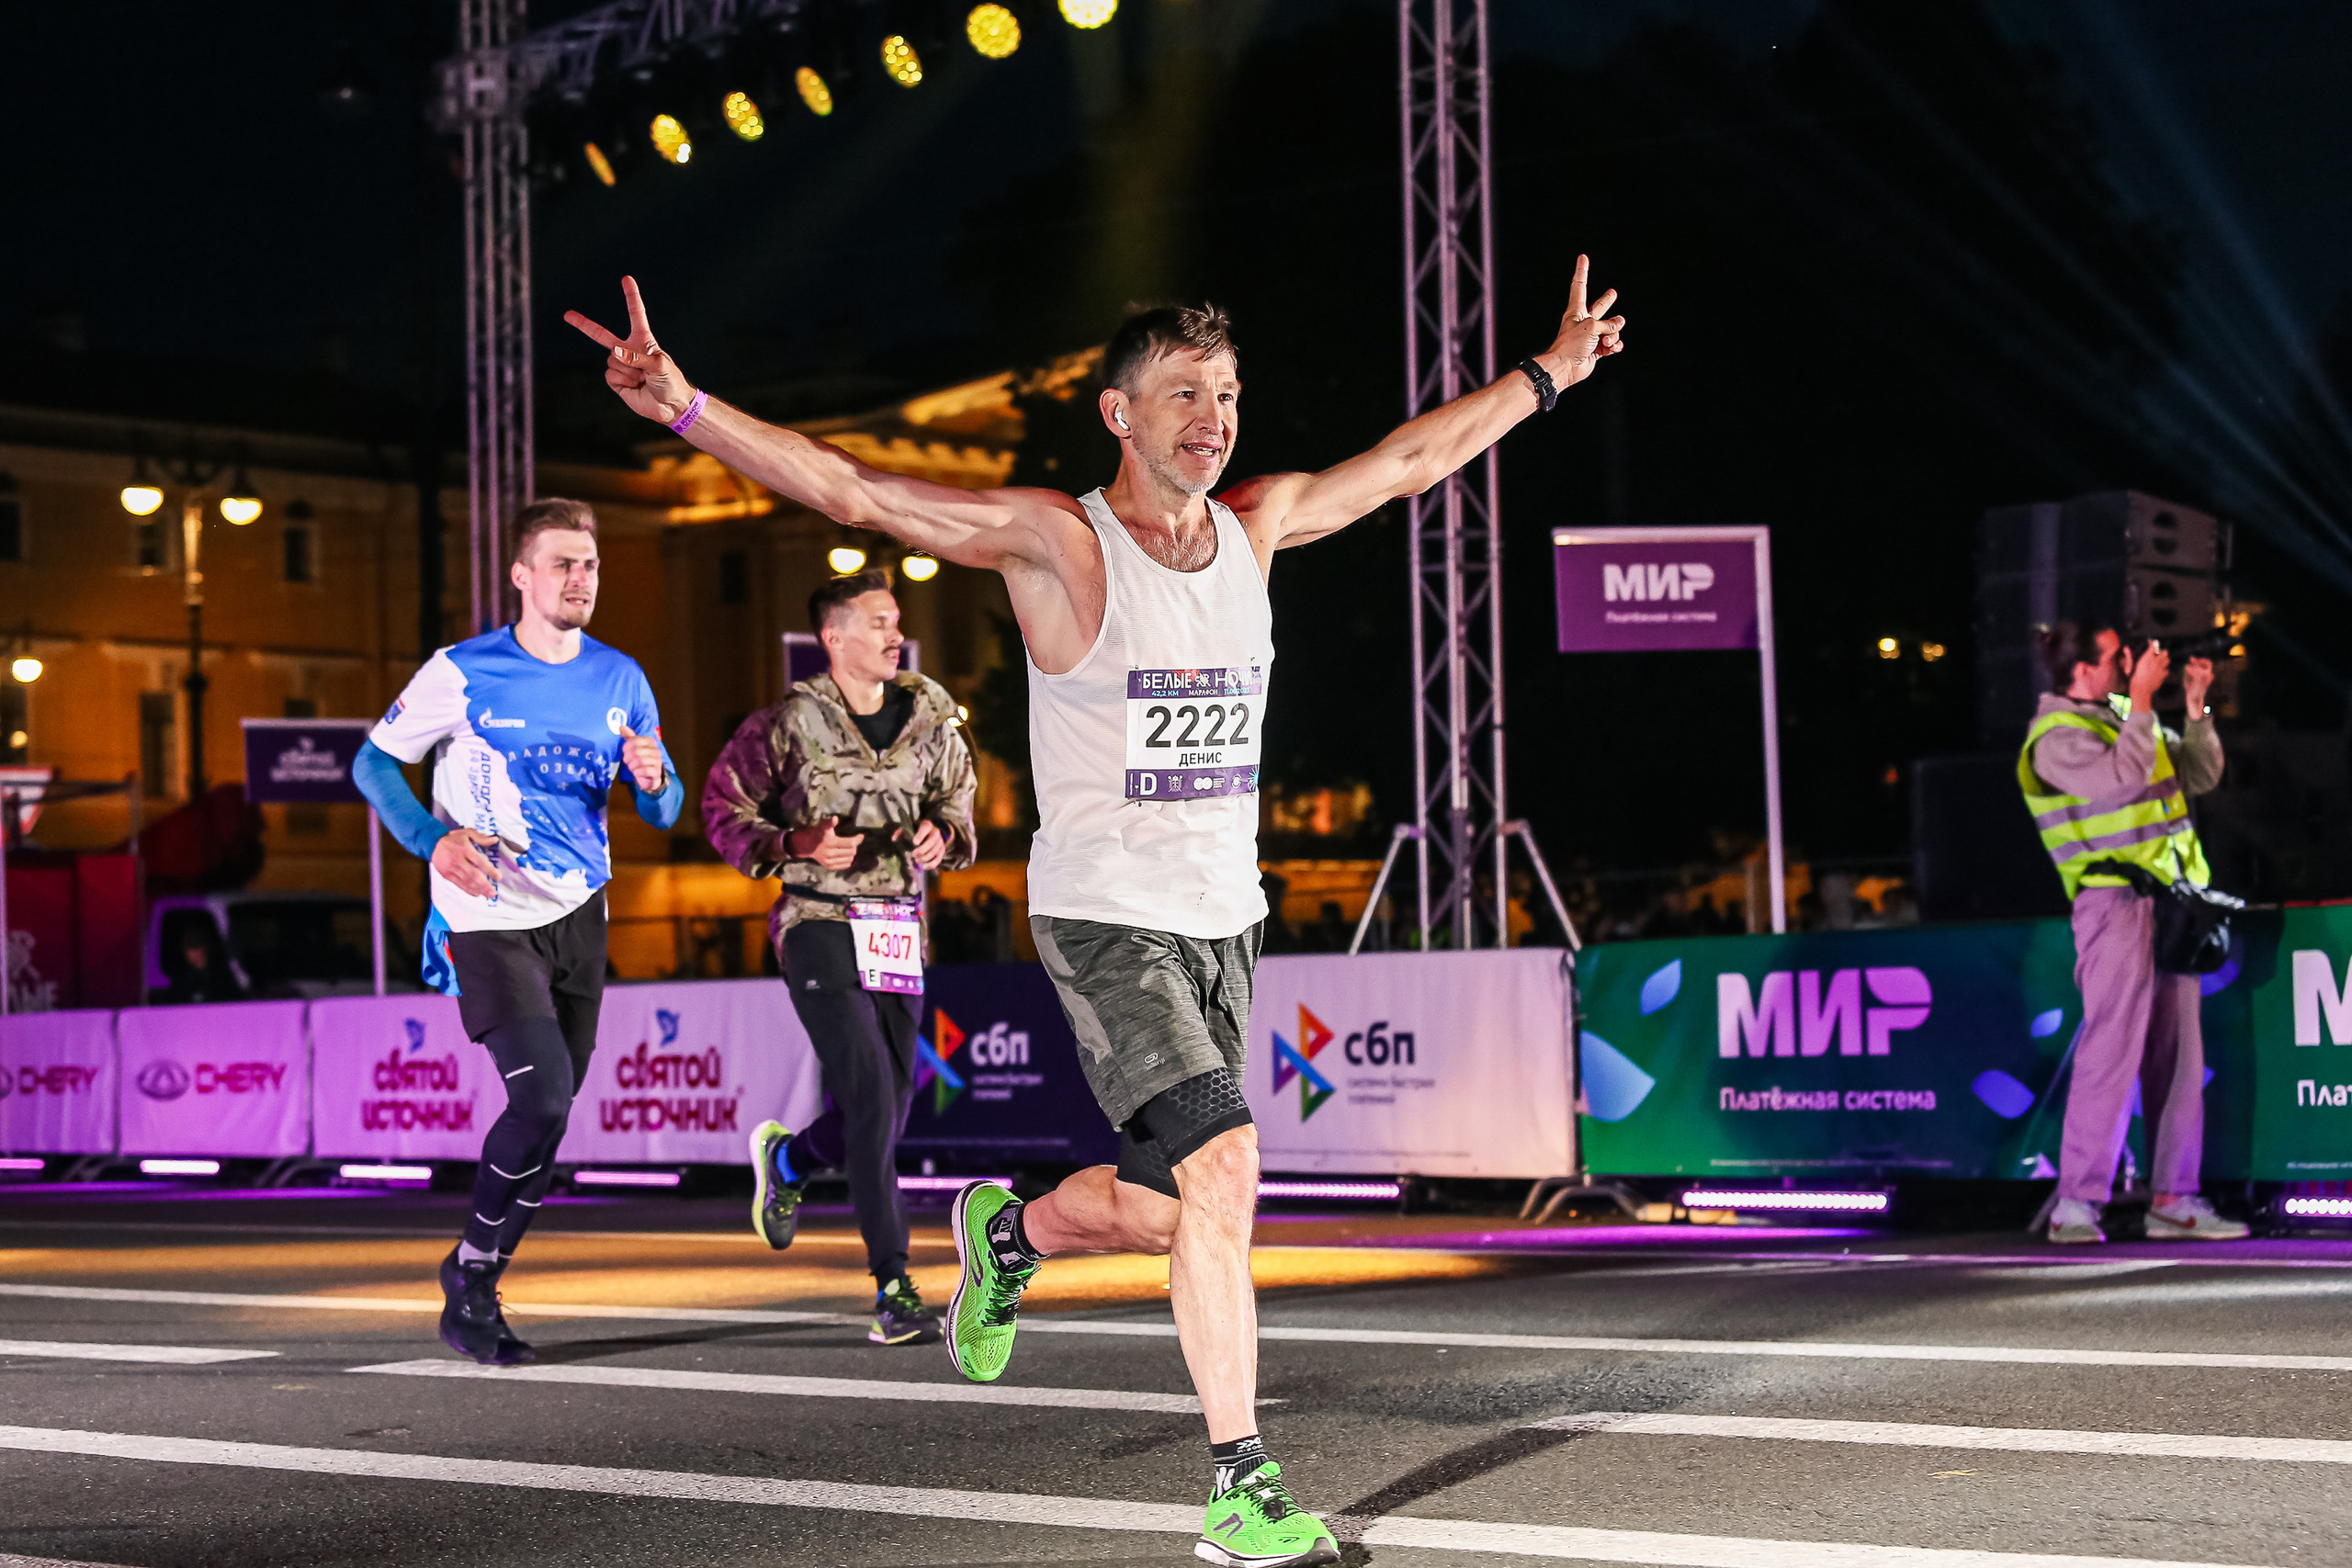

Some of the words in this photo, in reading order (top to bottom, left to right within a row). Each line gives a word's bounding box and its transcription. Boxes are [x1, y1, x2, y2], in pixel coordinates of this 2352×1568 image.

[1603, 563, 1714, 601] МИР
[1142, 672, 1192, 689] БЕЛЫЕ
[1146, 703, 1250, 748] 2222
[1179, 752, 1222, 767] ДЕНИС
[868, 932, 911, 960] 4307
[869, 969, 876, 982] E
[1716, 967, 1931, 1057] МИР
[969, 1021, 1029, 1066] сбп
[1344, 1021, 1416, 1066] сбп
[18, 1066, 98, 1095] CHERY
[196, 1062, 287, 1093] CHERY
[1720, 1086, 1838, 1111] Платёжная
[1844, 1090, 1937, 1110] система
